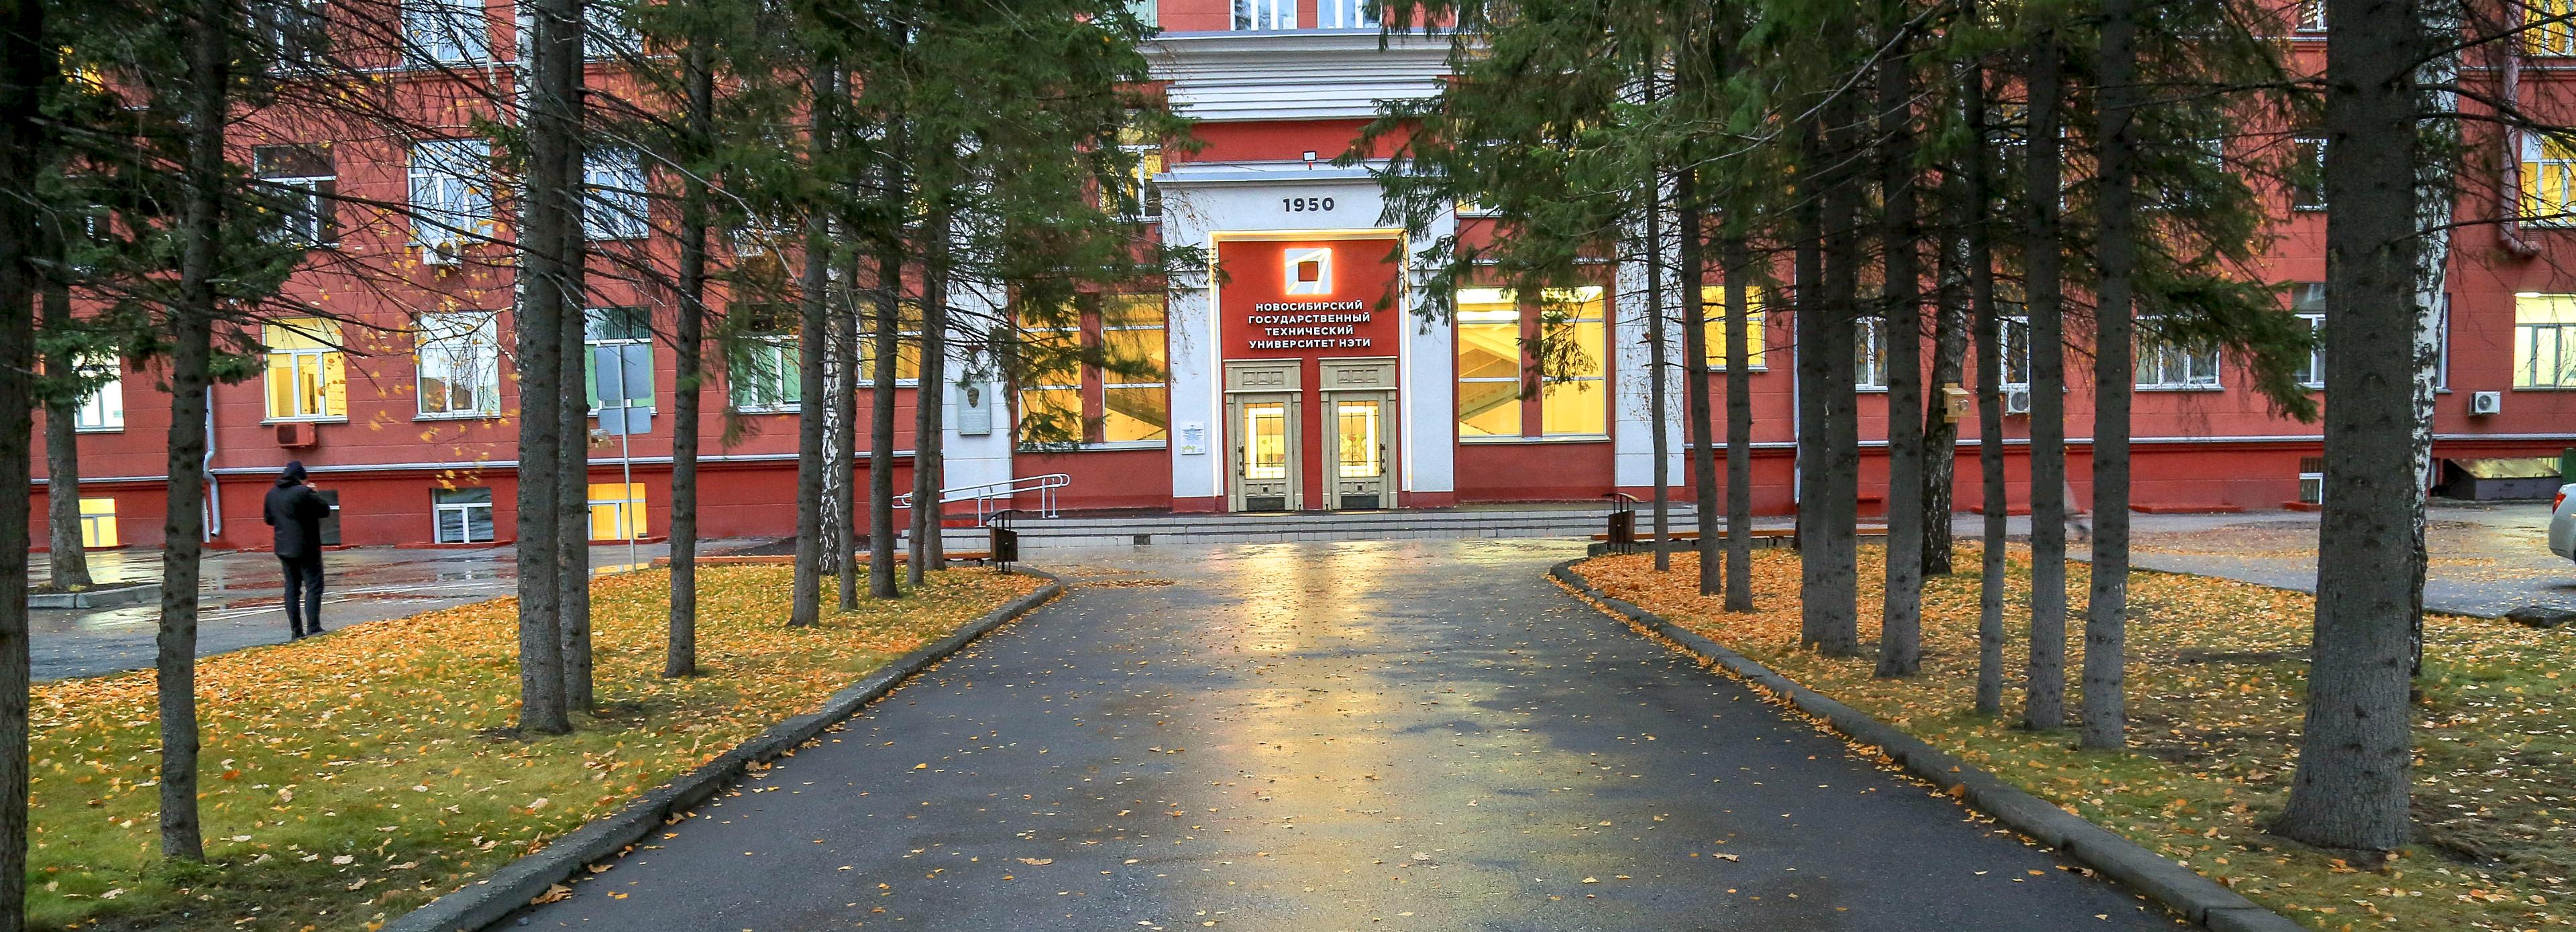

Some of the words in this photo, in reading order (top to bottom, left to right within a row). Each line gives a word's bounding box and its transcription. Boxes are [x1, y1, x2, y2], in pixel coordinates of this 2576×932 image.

[1283, 197, 1335, 213] 1950
[1255, 300, 1362, 312] НОВОСИБИРСКИЙ
[1248, 312, 1371, 325] ГОСУДАРСТВЕННЫЙ
[1265, 325, 1354, 336] ТЕХНИЧЕСКИЙ
[1249, 339, 1334, 349] УНИВЕРСИТЕТ
[1339, 338, 1371, 348] НЭТИ
